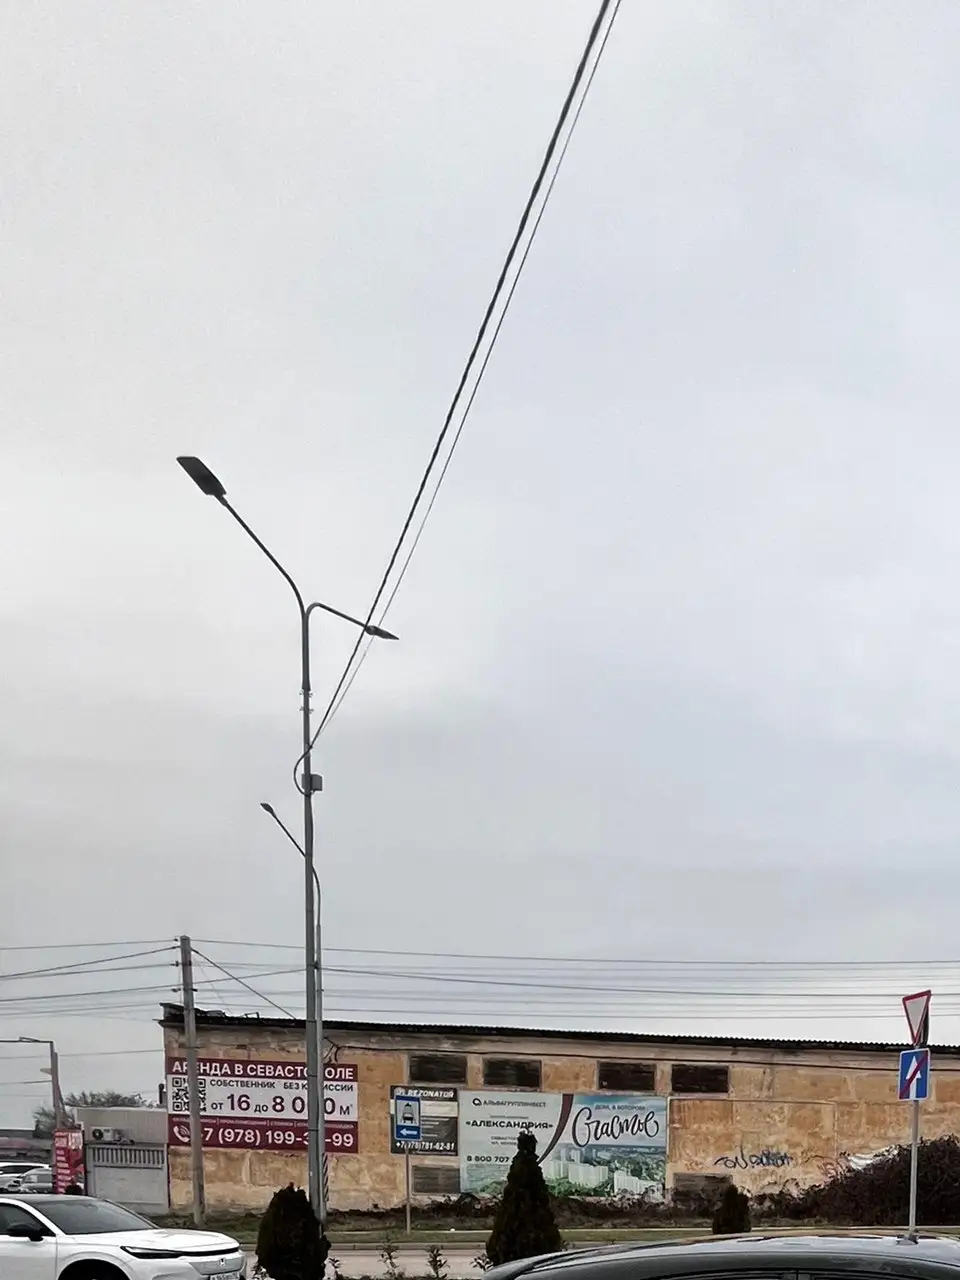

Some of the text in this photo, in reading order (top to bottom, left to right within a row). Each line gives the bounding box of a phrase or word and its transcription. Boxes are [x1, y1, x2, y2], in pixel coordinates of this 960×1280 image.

[172, 1061, 354, 1080] АРНДА В СЕВАСТООЛЕ
[209, 1079, 354, 1092] СОБСТВЕННИК БЕЗ КИССИИ
[407, 1090, 454, 1099] REZONATOR
[211, 1102, 224, 1111] от
[227, 1093, 251, 1111] 16
[254, 1104, 268, 1113] до
[292, 1096, 336, 1115] 00
[465, 1119, 554, 1130] «АЛЕКСАНДРИЯ»
[201, 1127, 354, 1147] 7 (978) 199-3-99
[475, 1155, 492, 1163] 800
